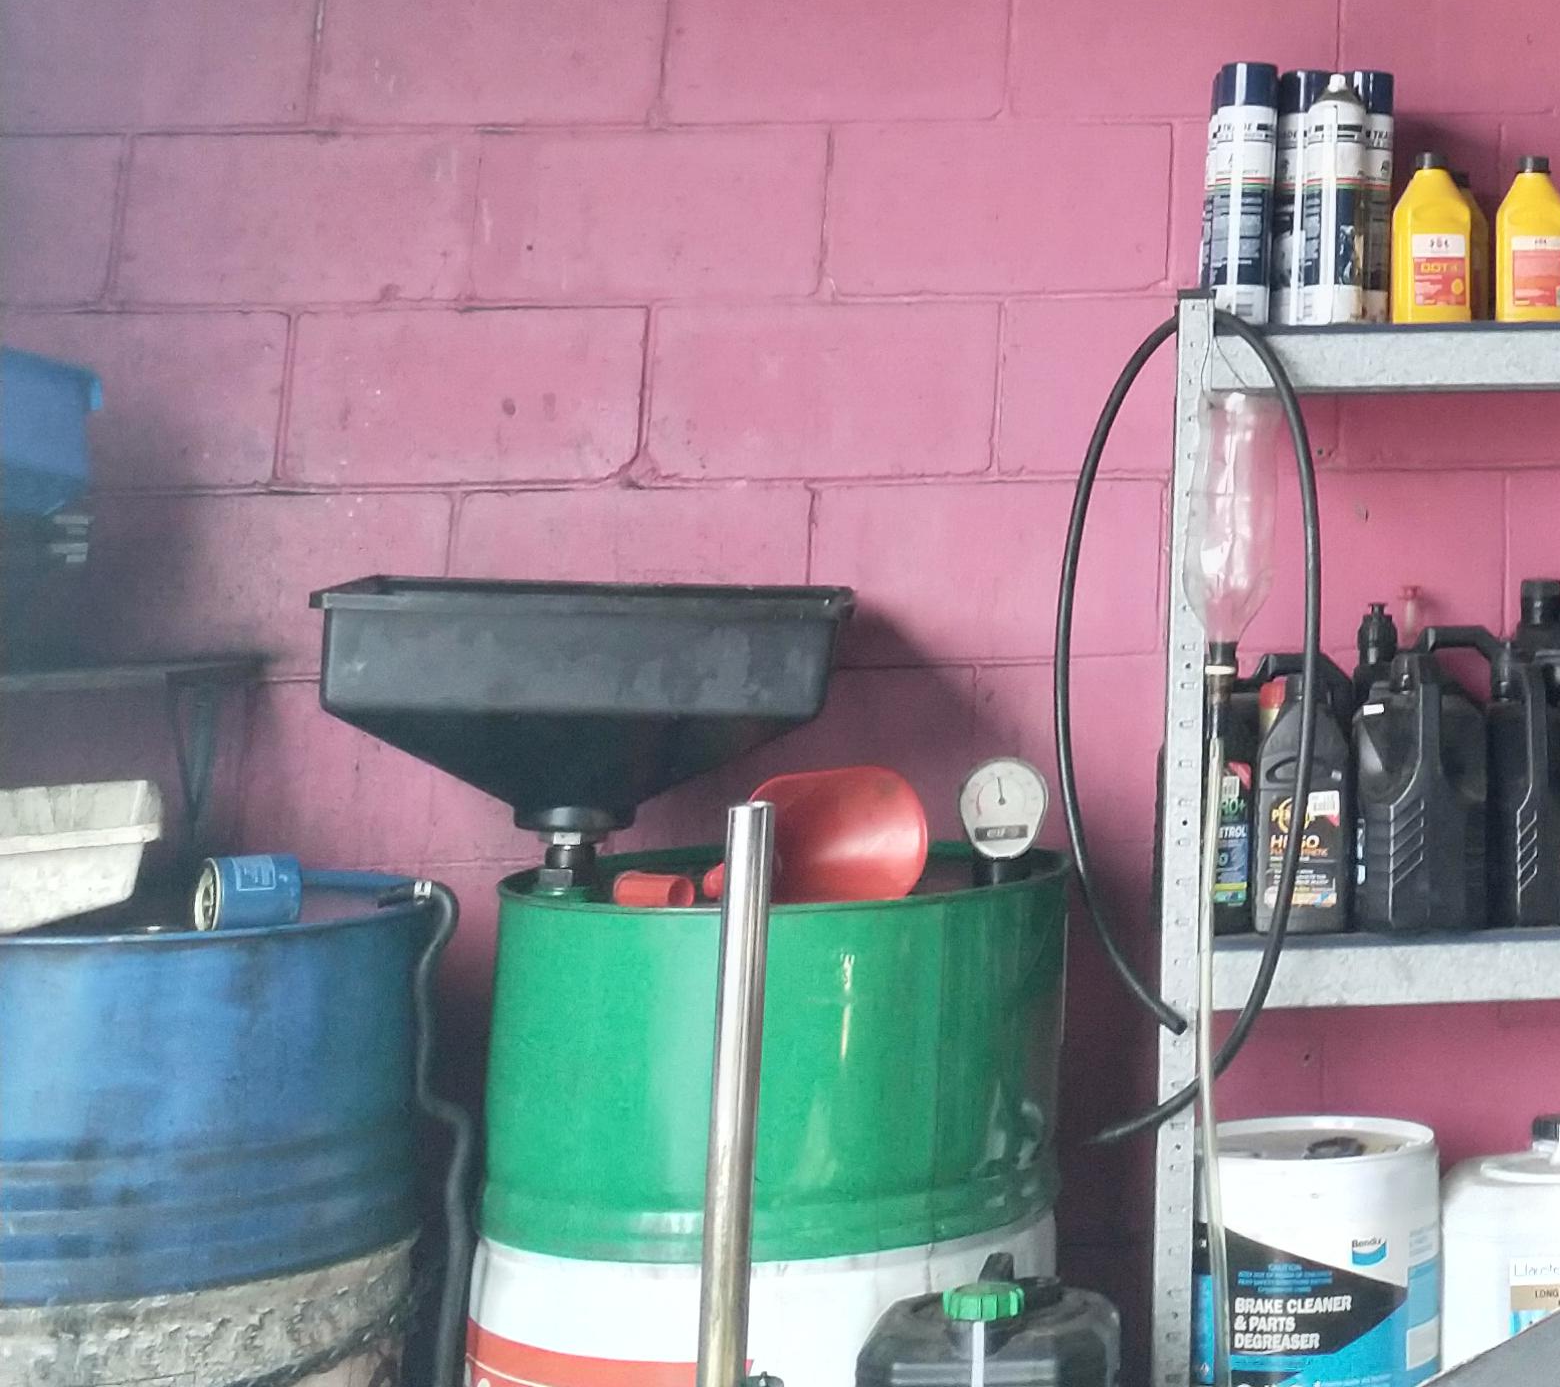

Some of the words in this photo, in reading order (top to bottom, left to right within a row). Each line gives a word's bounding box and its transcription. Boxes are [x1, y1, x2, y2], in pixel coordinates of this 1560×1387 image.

[1235, 1296, 1283, 1314] BRAKE
[1287, 1295, 1352, 1313] CLEANER
[1234, 1317, 1247, 1331] &
[1249, 1316, 1296, 1331] PARTS
[1234, 1333, 1320, 1350] DEGREASER
